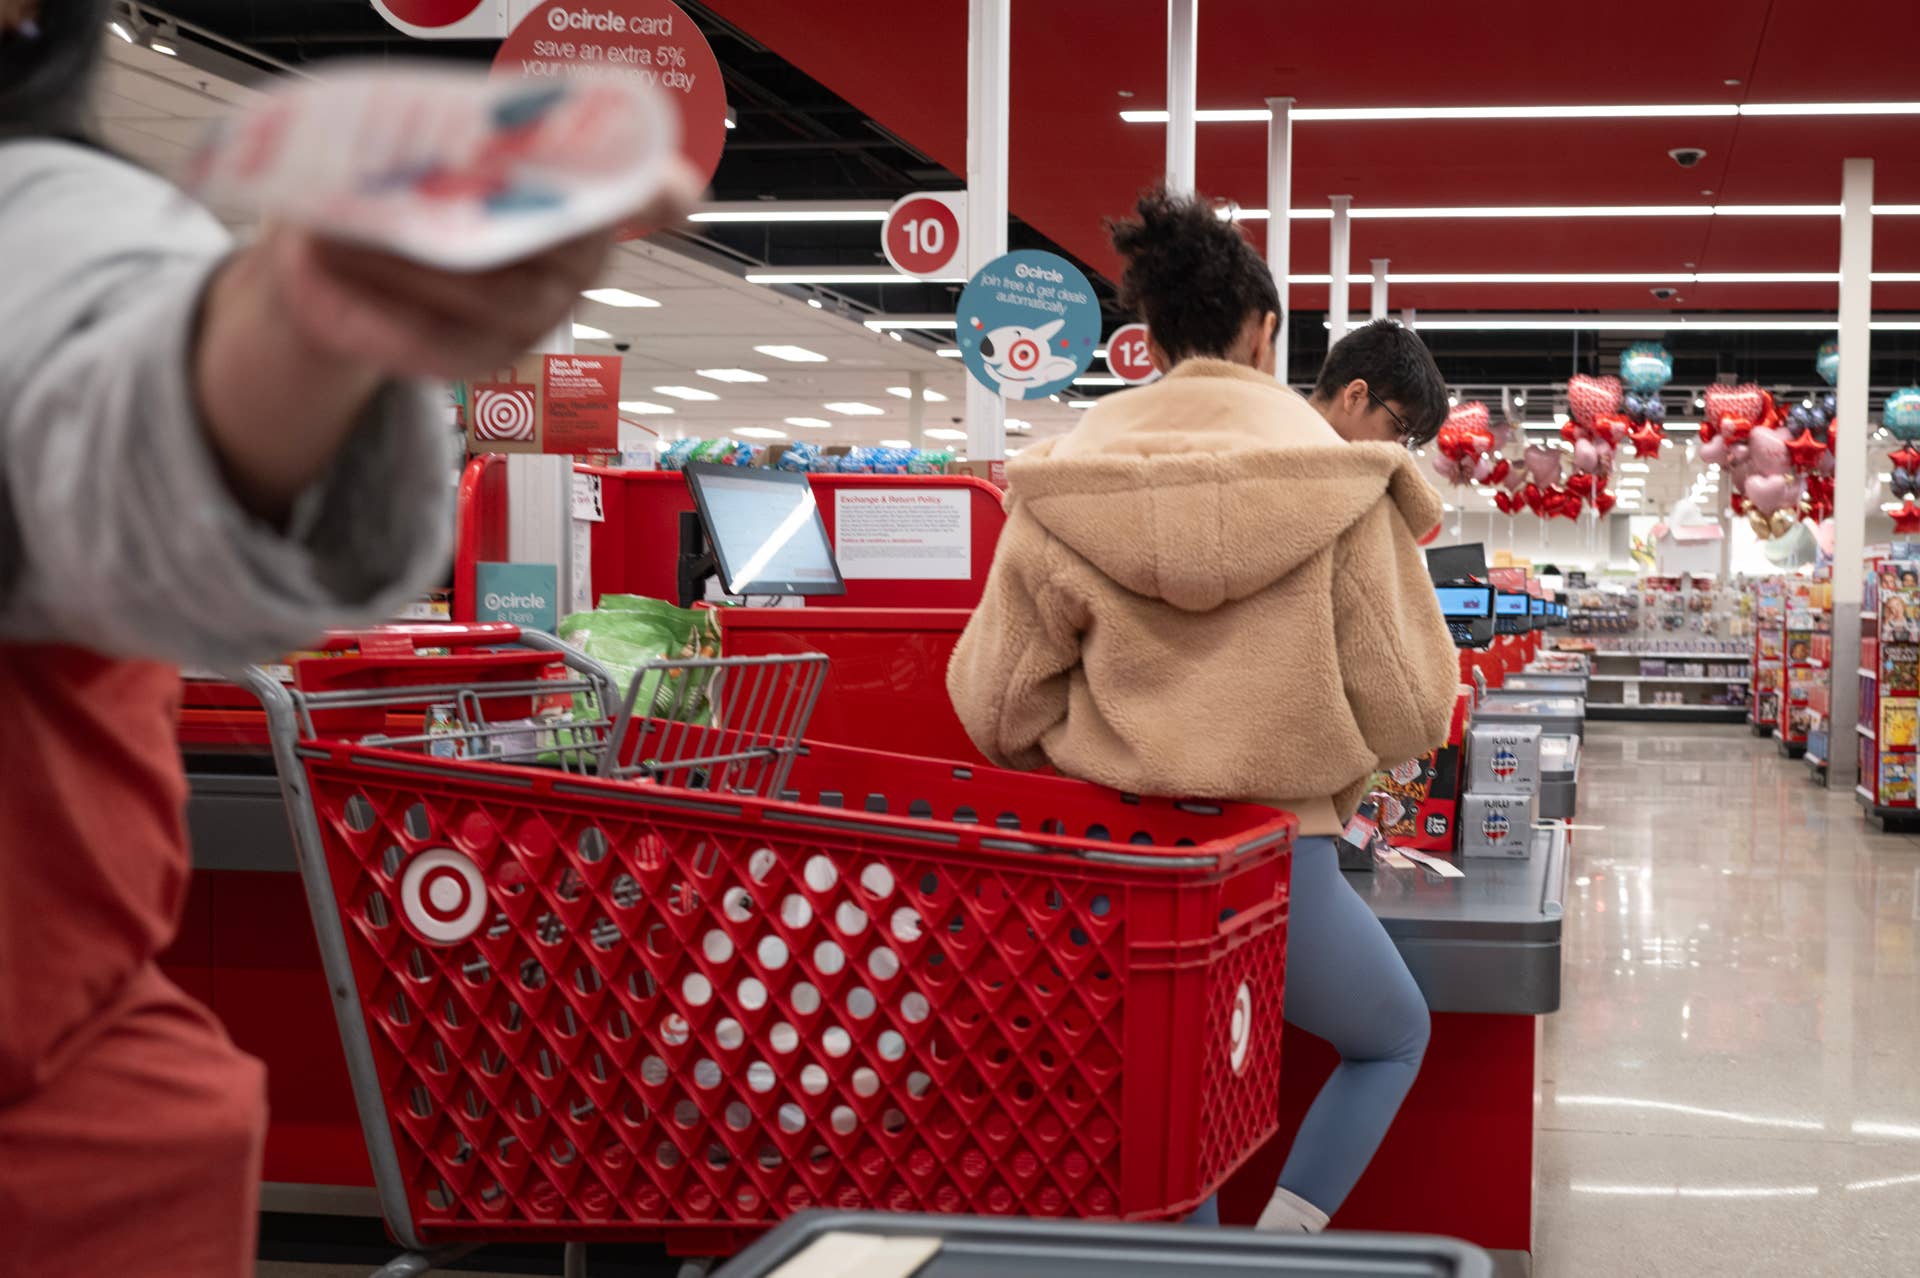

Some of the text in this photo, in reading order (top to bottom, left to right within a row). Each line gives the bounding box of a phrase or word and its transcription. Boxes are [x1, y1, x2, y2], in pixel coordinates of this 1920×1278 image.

[569, 8, 673, 36] circle card
[533, 39, 686, 68] save an extra 5%
[521, 58, 561, 79] your
[662, 68, 697, 94] day
[902, 218, 945, 254] 10
[1028, 265, 1064, 283] circle
[980, 273, 1088, 305] join free & get deals
[995, 291, 1067, 315] automatically
[1119, 341, 1150, 367] 12
[501, 592, 545, 609] circle
[508, 611, 534, 623] here
